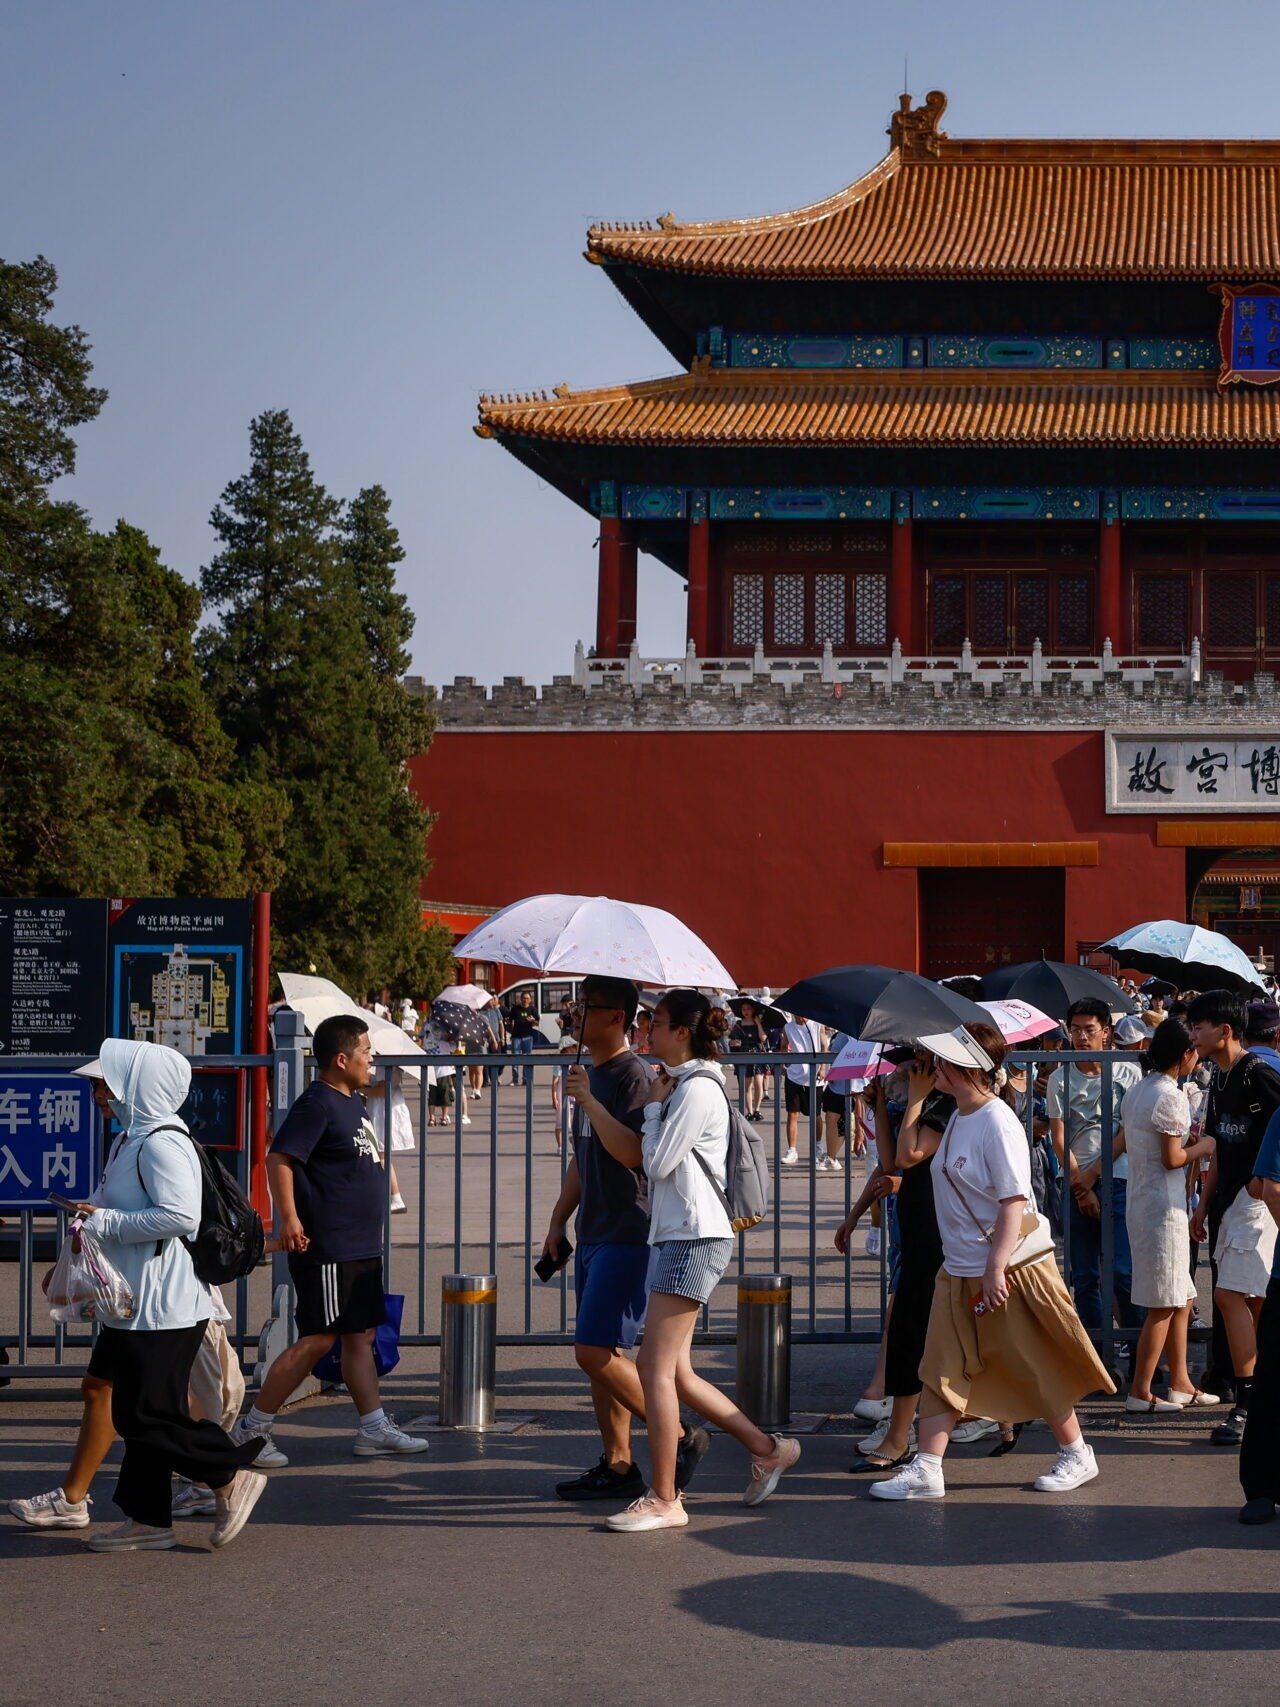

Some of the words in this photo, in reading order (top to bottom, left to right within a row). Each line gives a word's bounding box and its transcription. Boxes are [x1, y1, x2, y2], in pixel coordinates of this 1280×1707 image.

[137, 915, 224, 926] 故宫博物院平面图
[0, 1088, 80, 1134] 车辆
[0, 1143, 76, 1188] 入内
